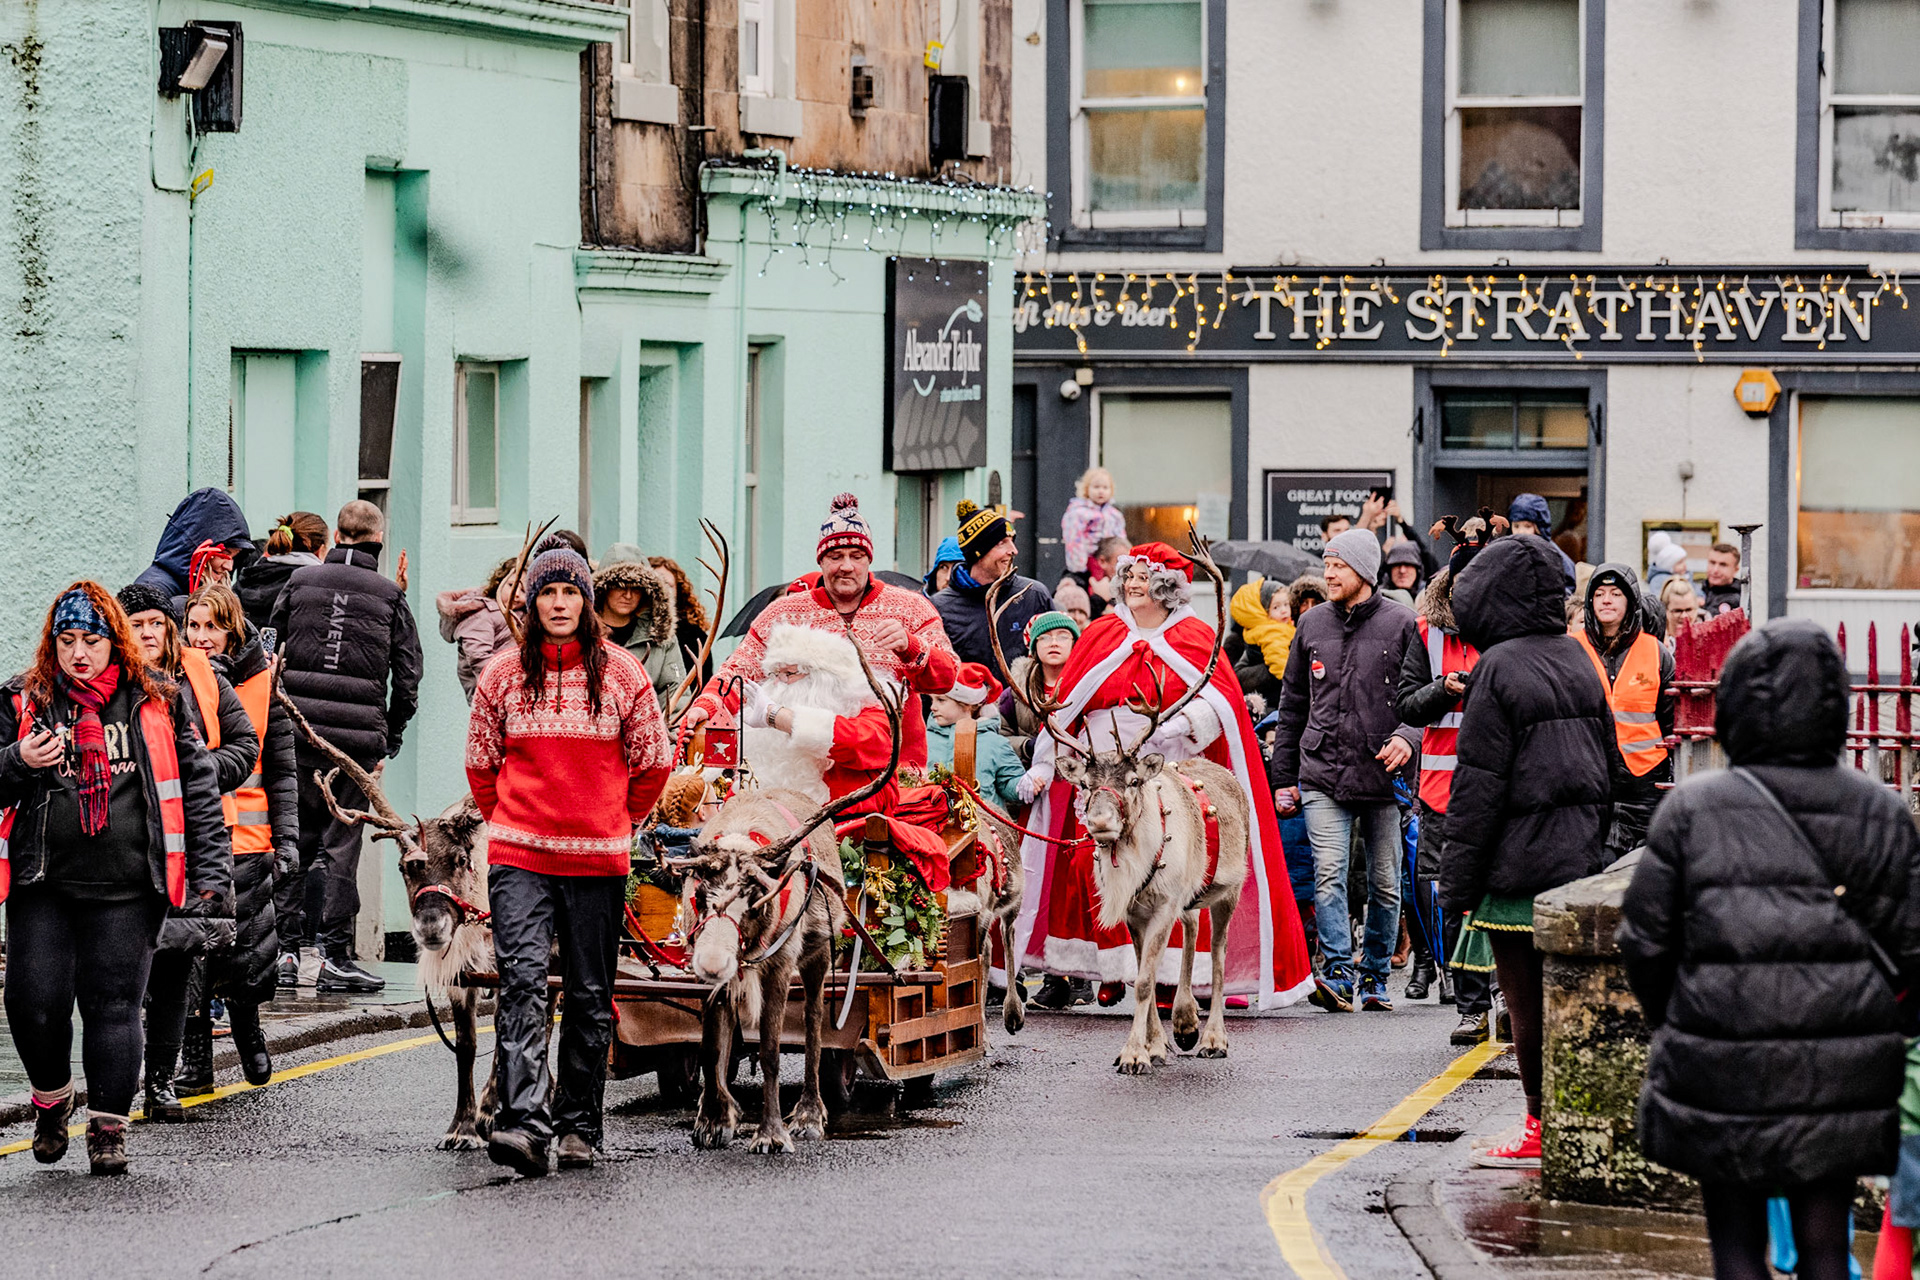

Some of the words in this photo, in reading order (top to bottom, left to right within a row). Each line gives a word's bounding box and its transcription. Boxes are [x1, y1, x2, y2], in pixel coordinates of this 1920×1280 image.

[1042, 300, 1091, 329] Ales
[1094, 300, 1116, 326] &
[1121, 300, 1169, 326] Beer
[1241, 289, 1384, 341] THE
[1405, 289, 1873, 342] STRATHAVEN
[903, 328, 952, 371] Alexander
[951, 328, 982, 386] Taylor
[1287, 489, 1332, 502] GREAT
[1298, 503, 1332, 516] Served
[1333, 504, 1360, 518] Daily
[323, 592, 349, 670] ZAVETTI
